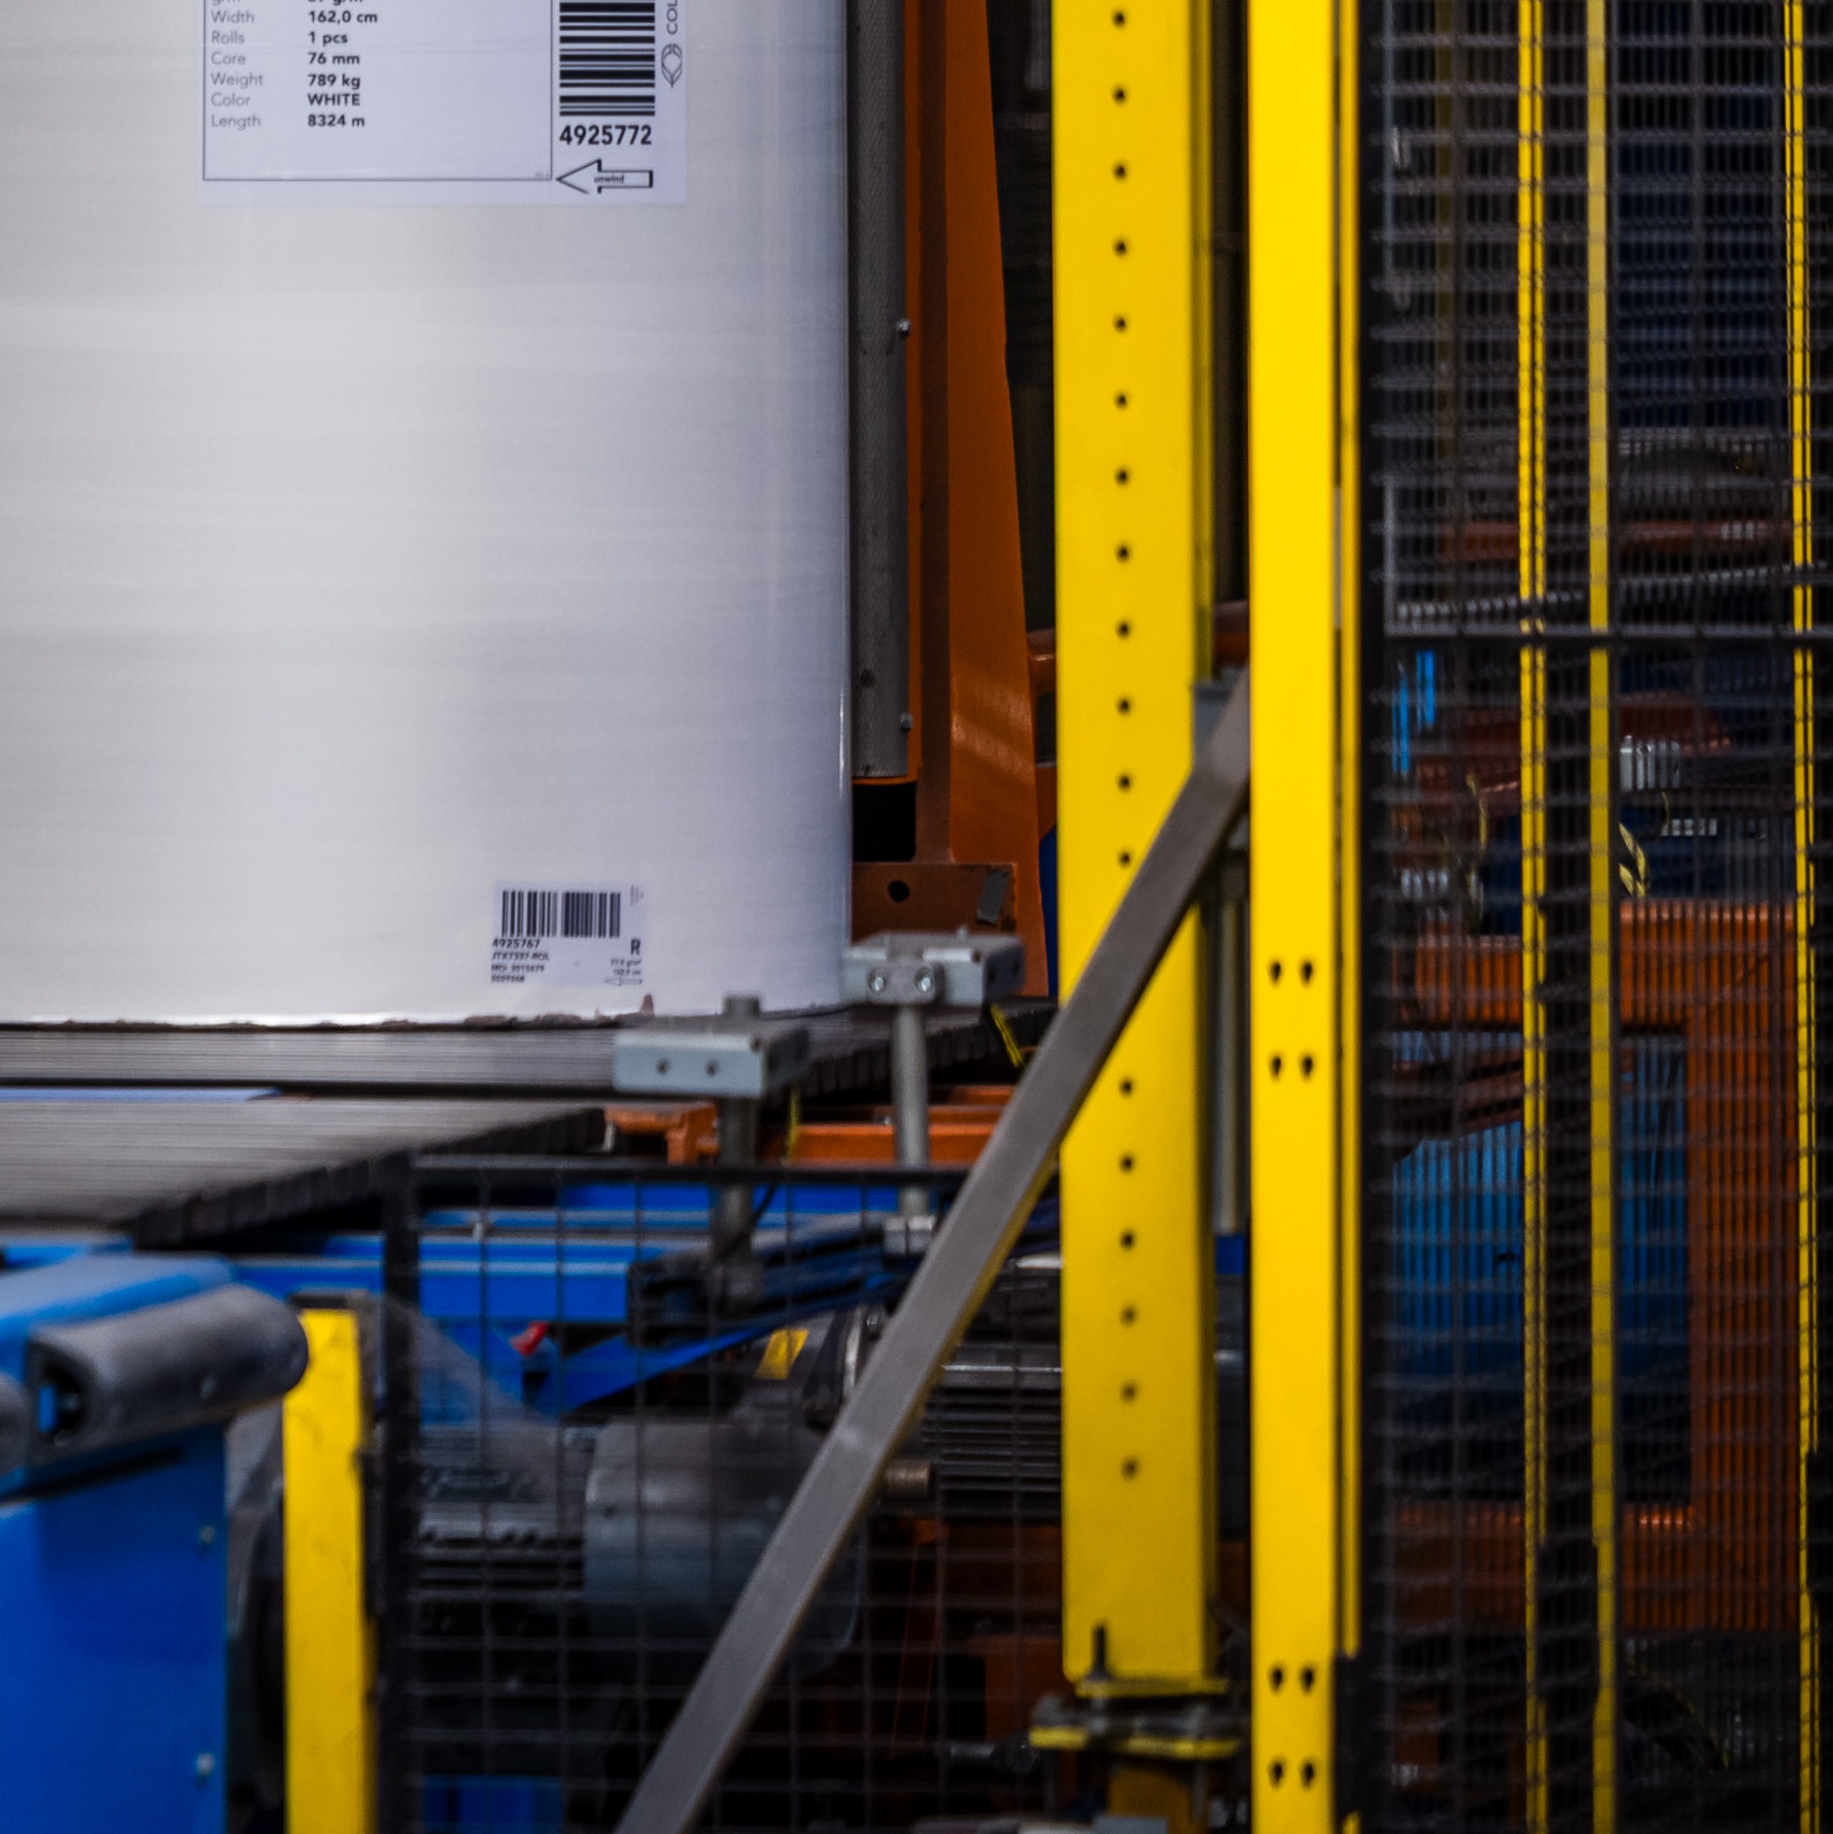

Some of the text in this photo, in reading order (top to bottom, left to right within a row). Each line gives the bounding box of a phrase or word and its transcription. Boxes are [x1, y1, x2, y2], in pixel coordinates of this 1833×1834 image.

[210, 9, 379, 26] Width 162,0 cm
[210, 30, 349, 48] Rolls 1 pcs
[210, 51, 361, 66] Core 76 mm
[210, 71, 361, 90] Weight 789 kg
[210, 92, 361, 108] Color WHITE
[210, 113, 366, 132] Length 8324 m
[558, 124, 653, 146] 4925772
[492, 938, 541, 949] 4925767
[630, 938, 642, 956] R
